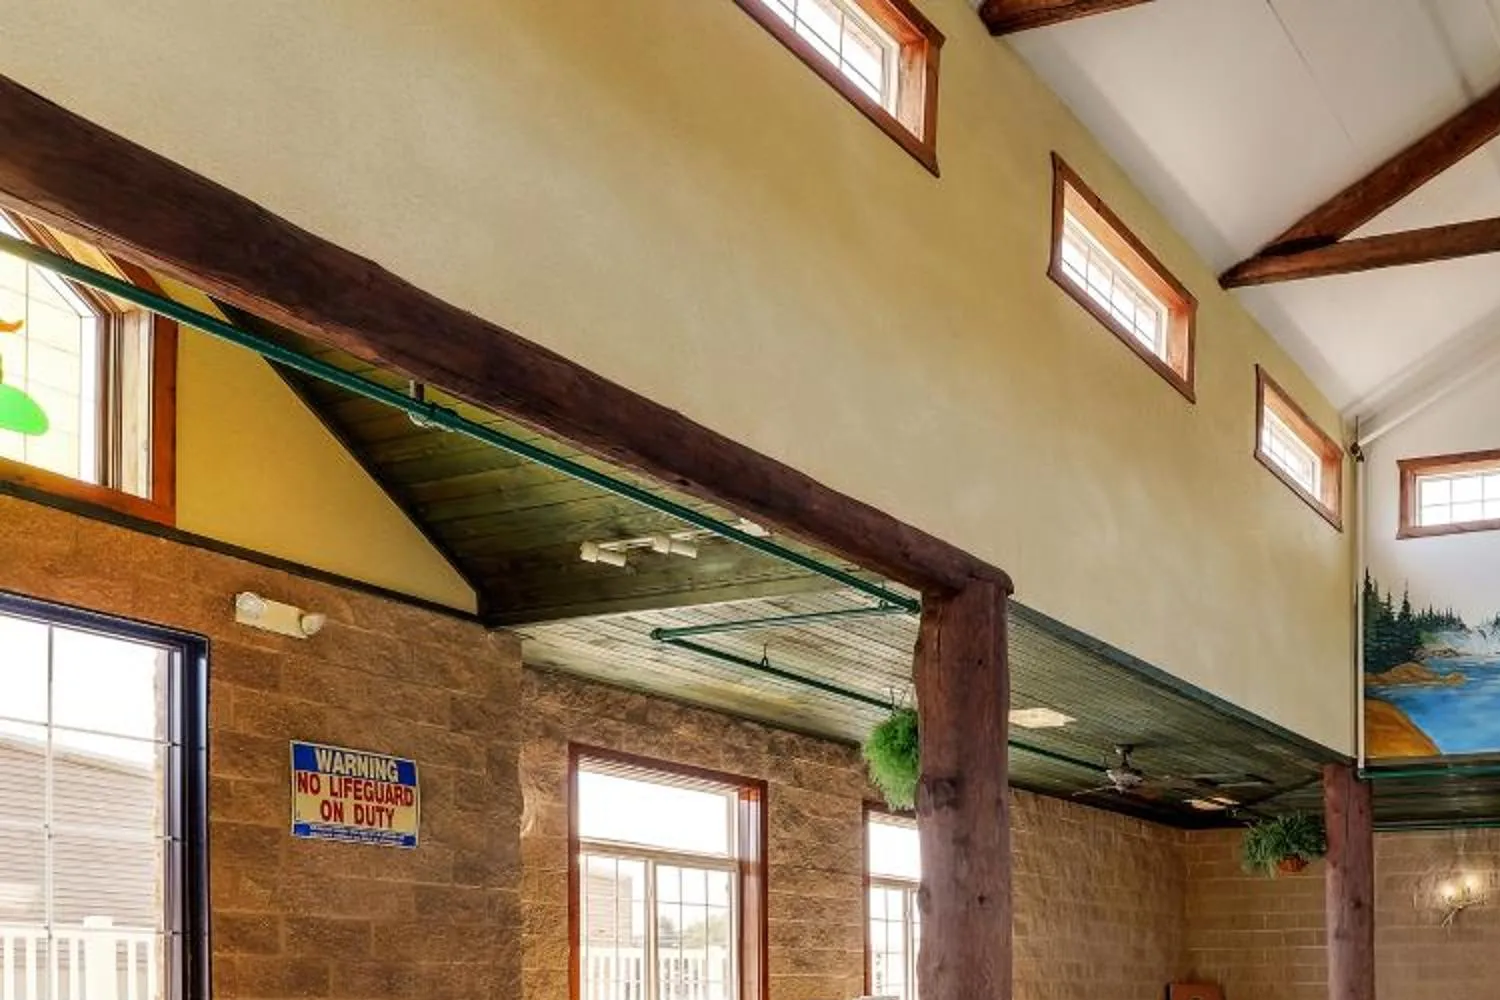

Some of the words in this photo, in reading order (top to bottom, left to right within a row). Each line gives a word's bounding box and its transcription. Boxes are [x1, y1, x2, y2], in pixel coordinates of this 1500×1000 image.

[315, 747, 399, 782] WARNING
[297, 772, 320, 795] NO
[329, 776, 414, 806] LIFEGUARD
[320, 799, 344, 822] ON
[353, 804, 395, 828] DUTY
